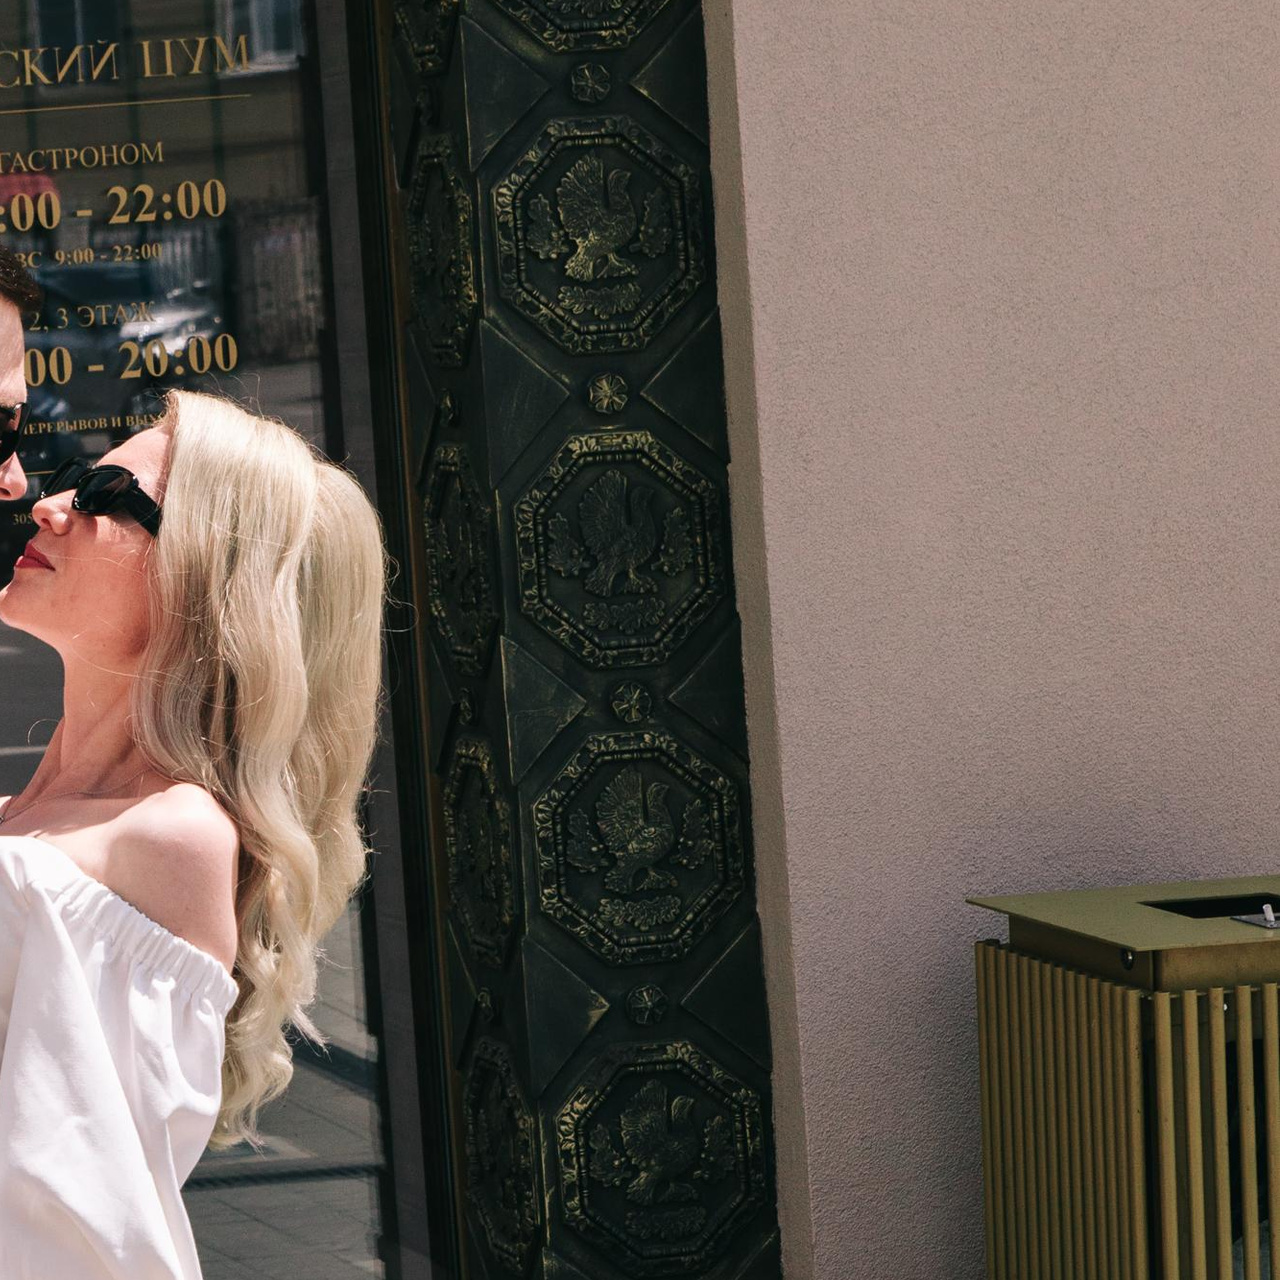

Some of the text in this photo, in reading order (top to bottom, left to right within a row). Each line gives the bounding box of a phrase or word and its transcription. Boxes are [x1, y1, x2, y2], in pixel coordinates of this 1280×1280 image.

[140, 34, 251, 78] ЦУМ
[106, 179, 227, 225] 22:00
[55, 247, 94, 266] 9:00
[112, 243, 162, 262] 22:00
[28, 301, 155, 332] 2, 3 ЭТАЖ
[118, 333, 238, 380] 20:00
[111, 416, 121, 427] И
